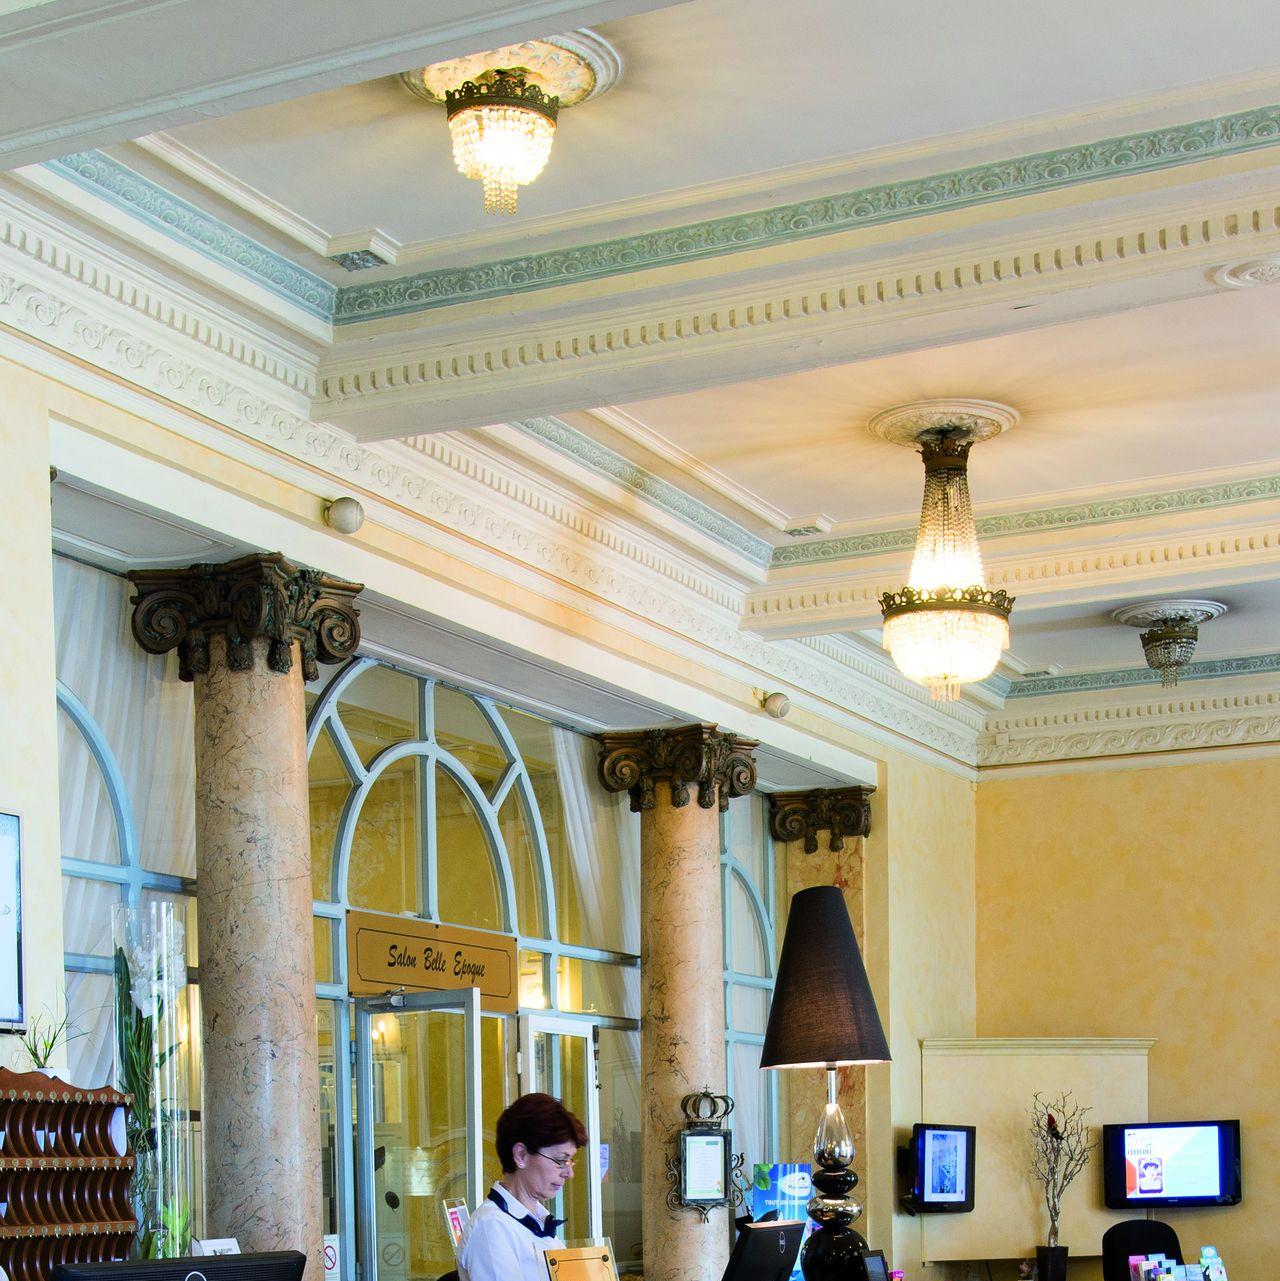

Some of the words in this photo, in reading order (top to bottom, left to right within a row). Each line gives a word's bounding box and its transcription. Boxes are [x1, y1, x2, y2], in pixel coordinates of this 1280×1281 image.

[387, 944, 417, 968] Salon
[423, 946, 447, 972] Belle
[453, 951, 486, 983] Epoque
